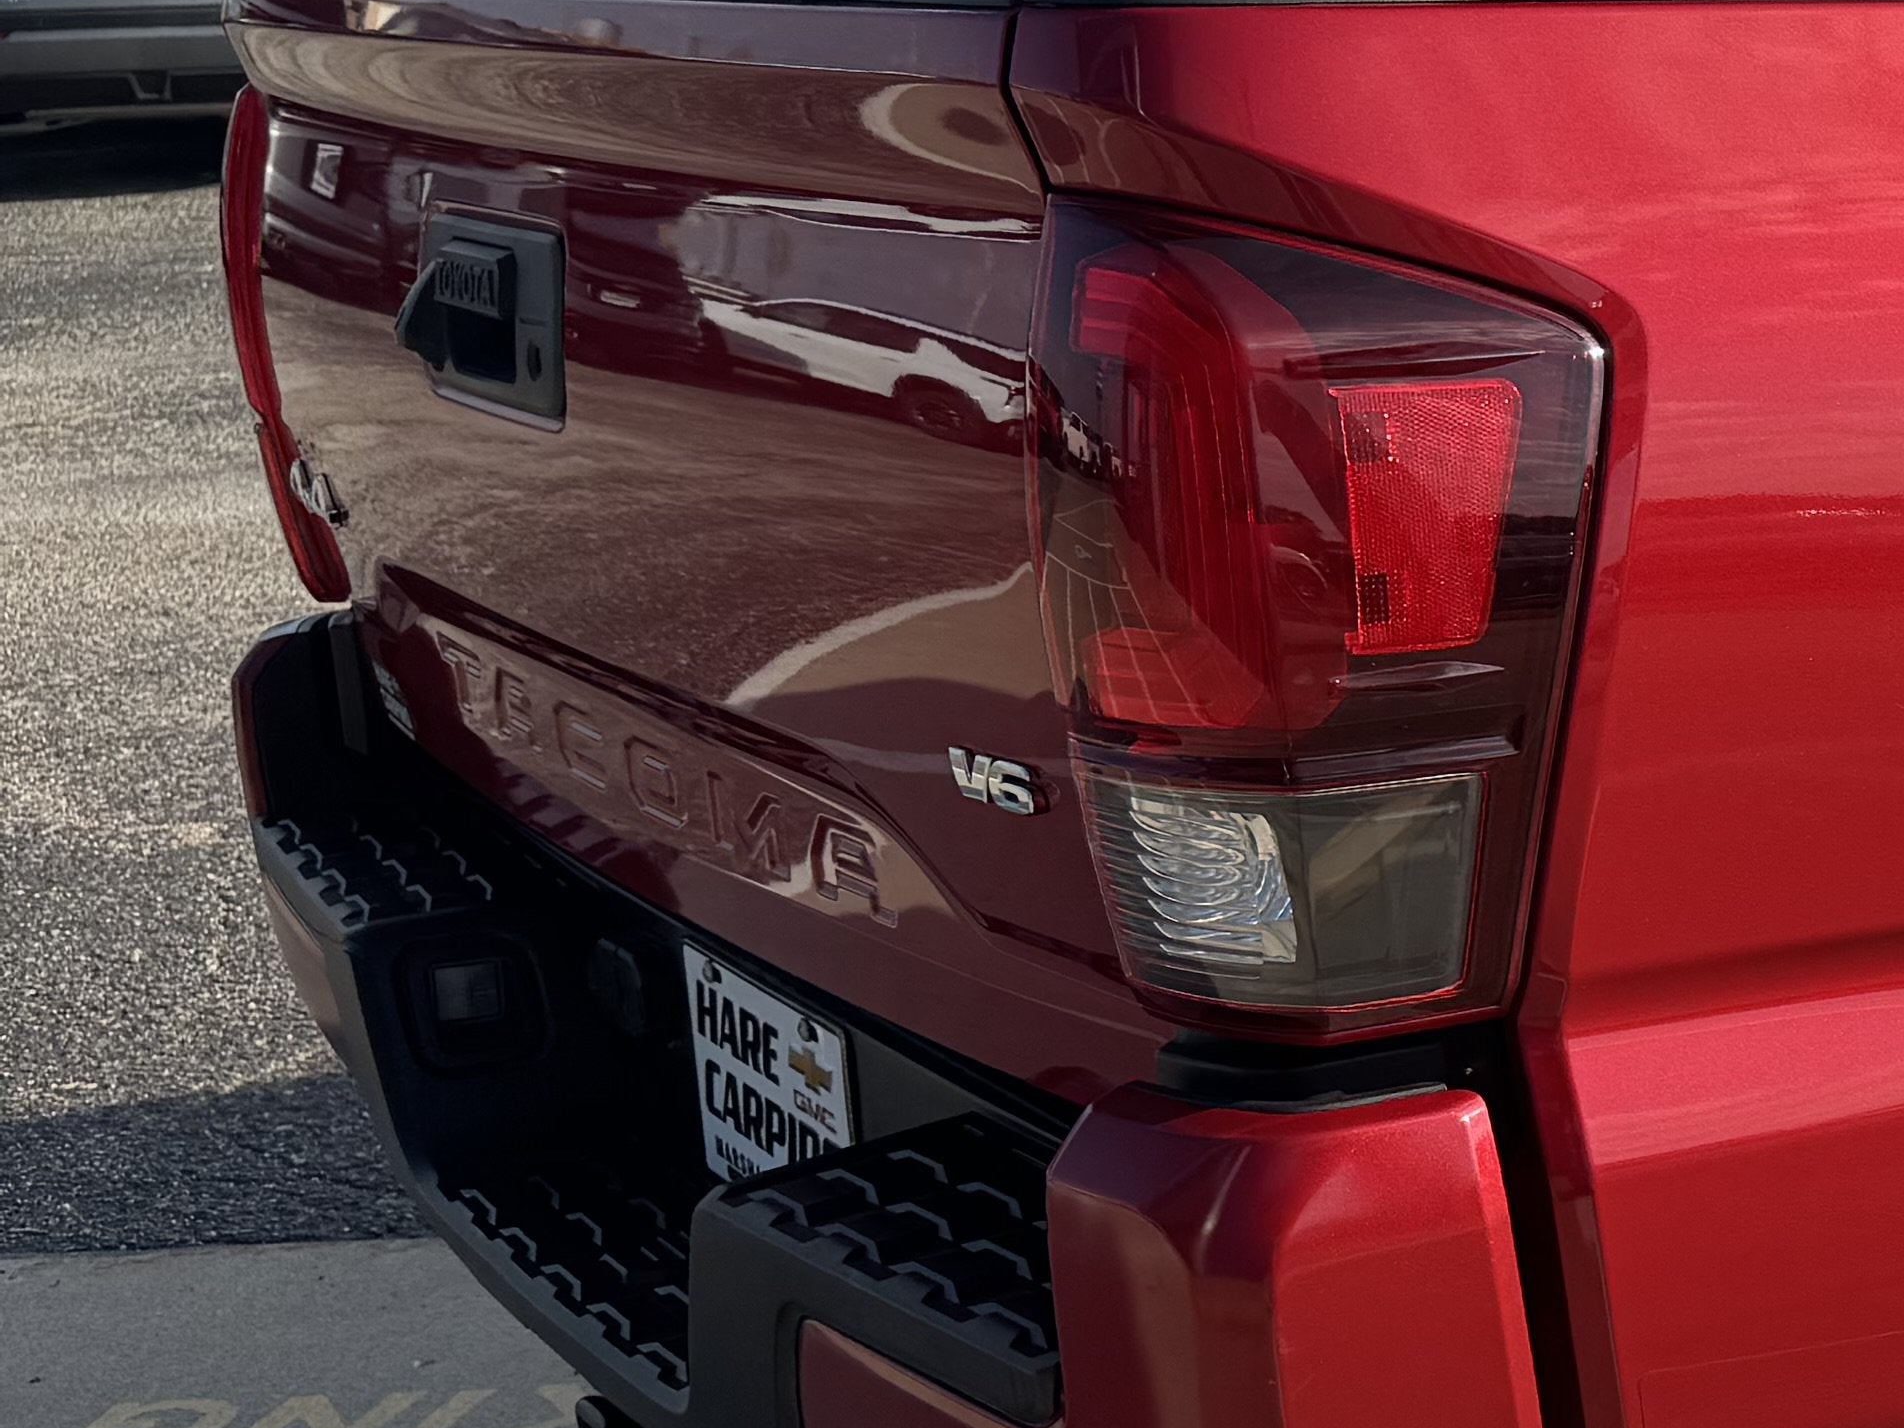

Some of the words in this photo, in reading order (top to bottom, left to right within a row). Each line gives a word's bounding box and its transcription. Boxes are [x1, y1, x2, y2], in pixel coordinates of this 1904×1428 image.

[434, 260, 497, 308] TOYOTA
[436, 630, 900, 928] TACOMA
[948, 746, 1035, 816] V6
[696, 979, 780, 1086] HARE
[793, 1089, 837, 1135] GMC
